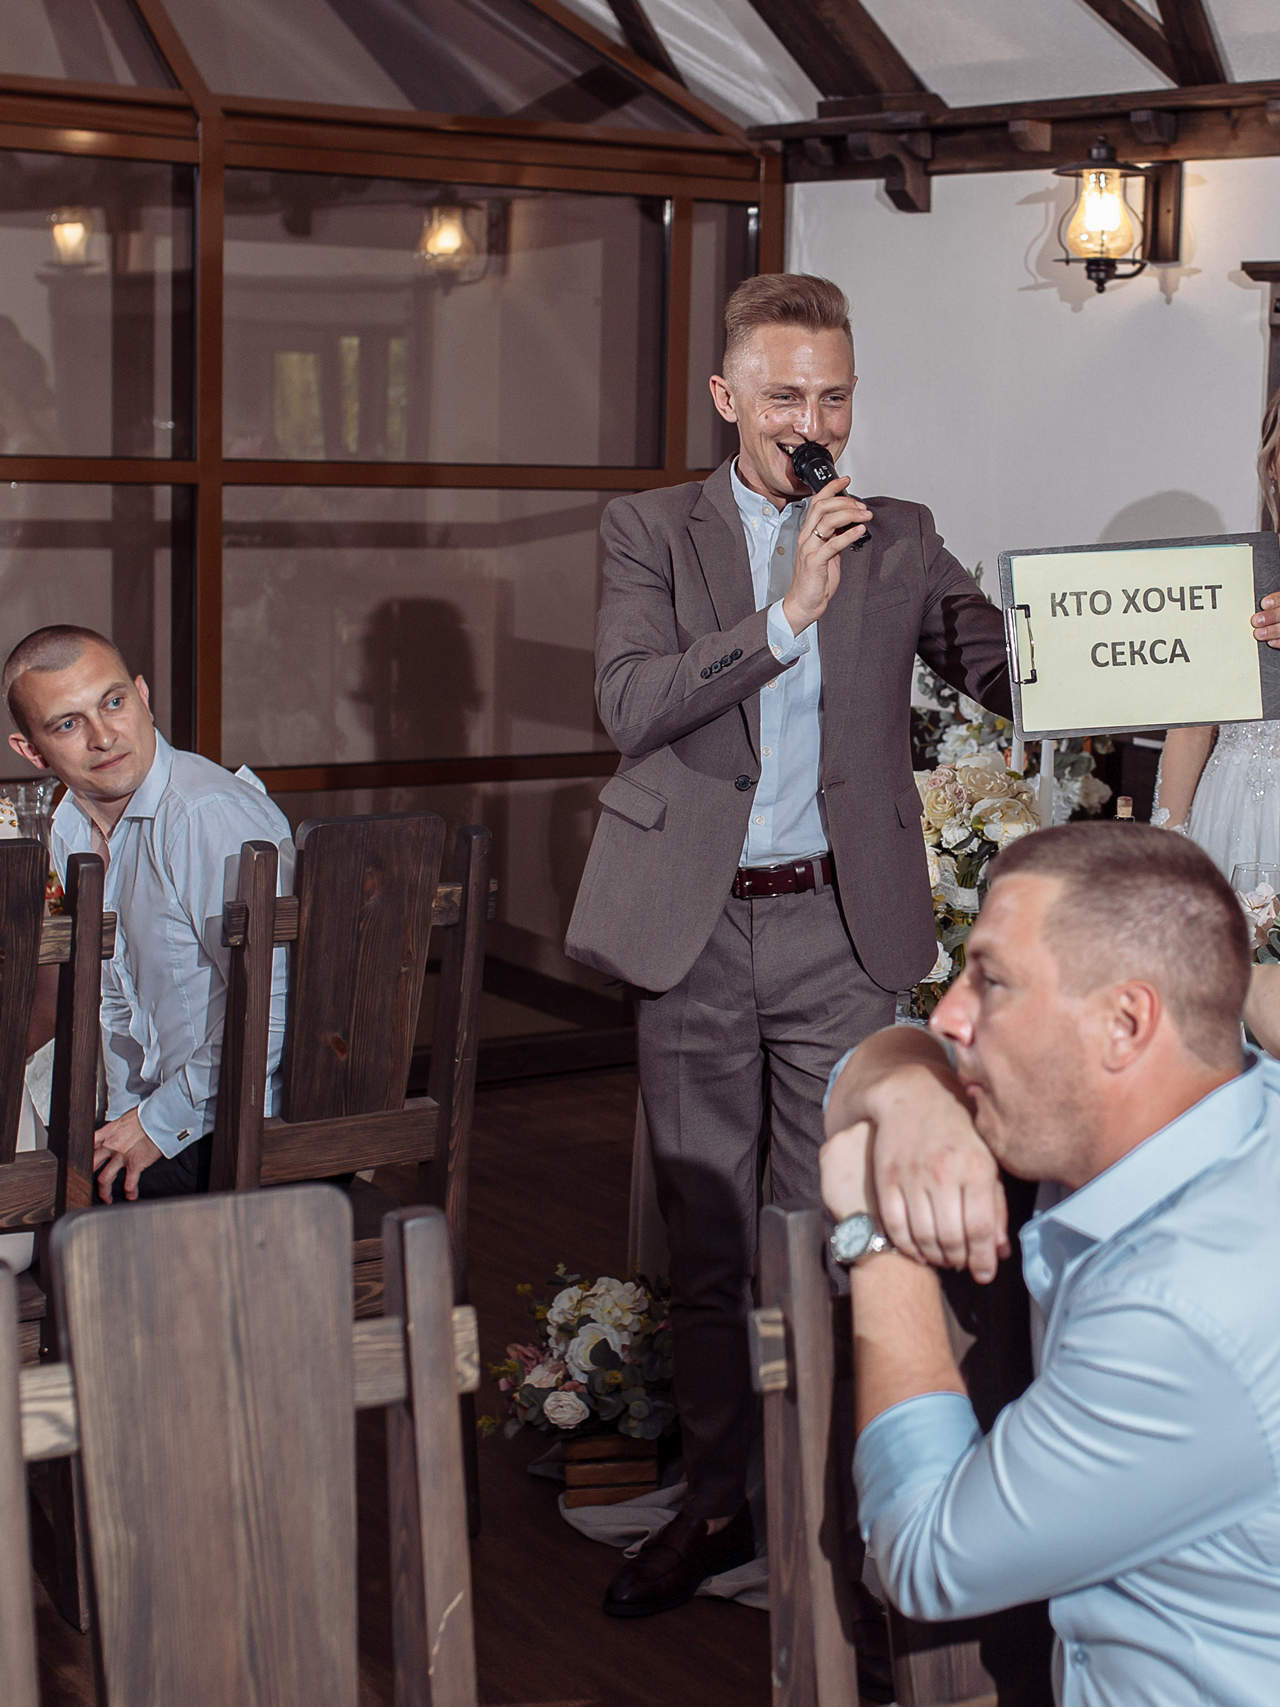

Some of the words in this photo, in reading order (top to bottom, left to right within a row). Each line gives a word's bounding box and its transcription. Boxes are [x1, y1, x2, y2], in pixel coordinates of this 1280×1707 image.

[1050, 589, 1112, 617] КТО
[1121, 584, 1223, 614] ХОЧЕТ
[1090, 638, 1191, 668] СЕКСА
